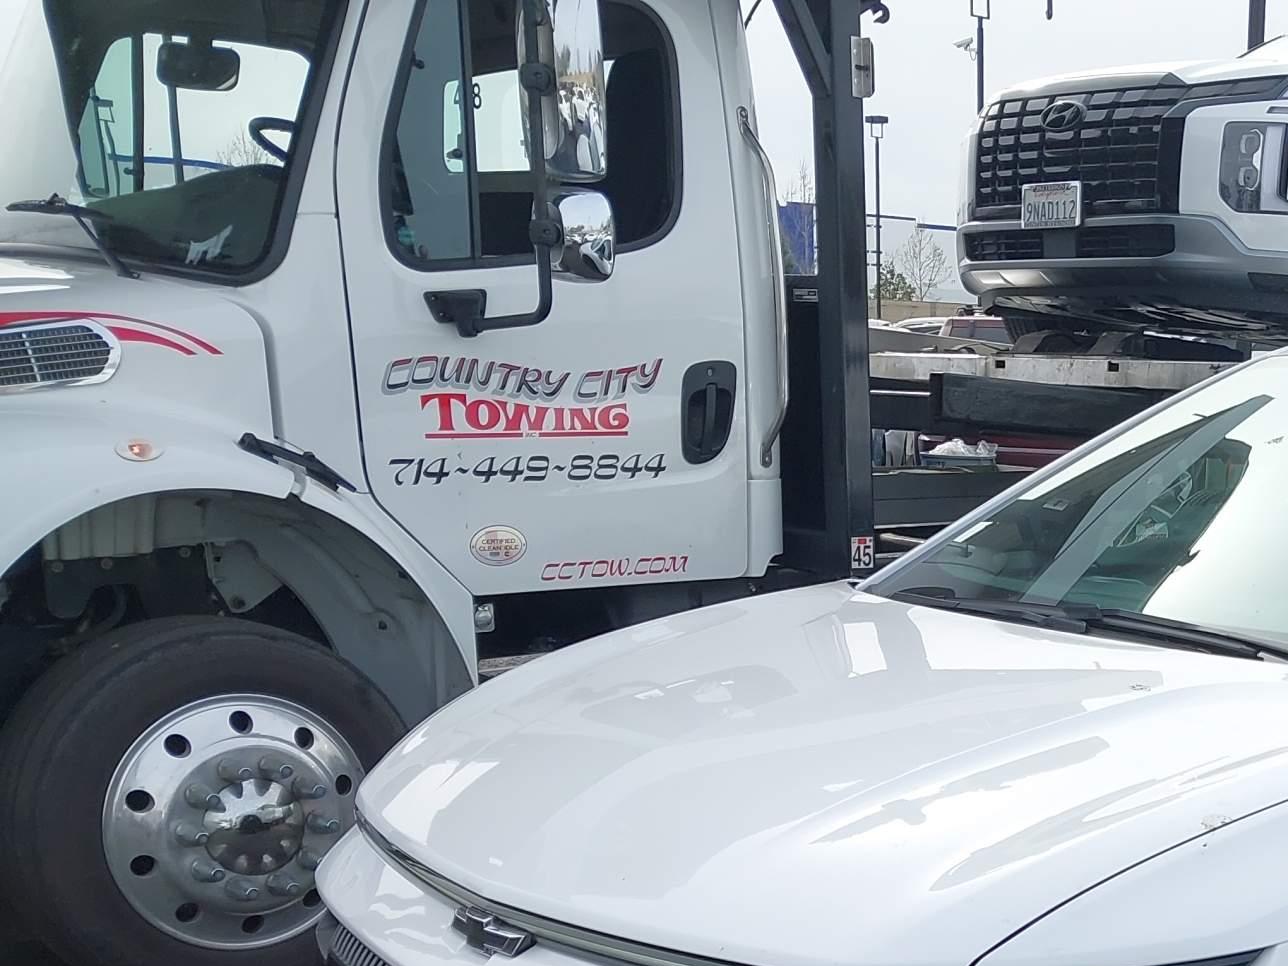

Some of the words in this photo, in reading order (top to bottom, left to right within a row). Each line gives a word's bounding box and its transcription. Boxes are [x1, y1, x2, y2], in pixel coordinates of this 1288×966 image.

[1026, 199, 1076, 222] 9NAD112
[382, 355, 571, 399] COUNTRY
[574, 357, 663, 401] CITY
[419, 392, 630, 432] TOWING
[541, 555, 689, 581] CCTOW.COM
[852, 545, 872, 567] 45
